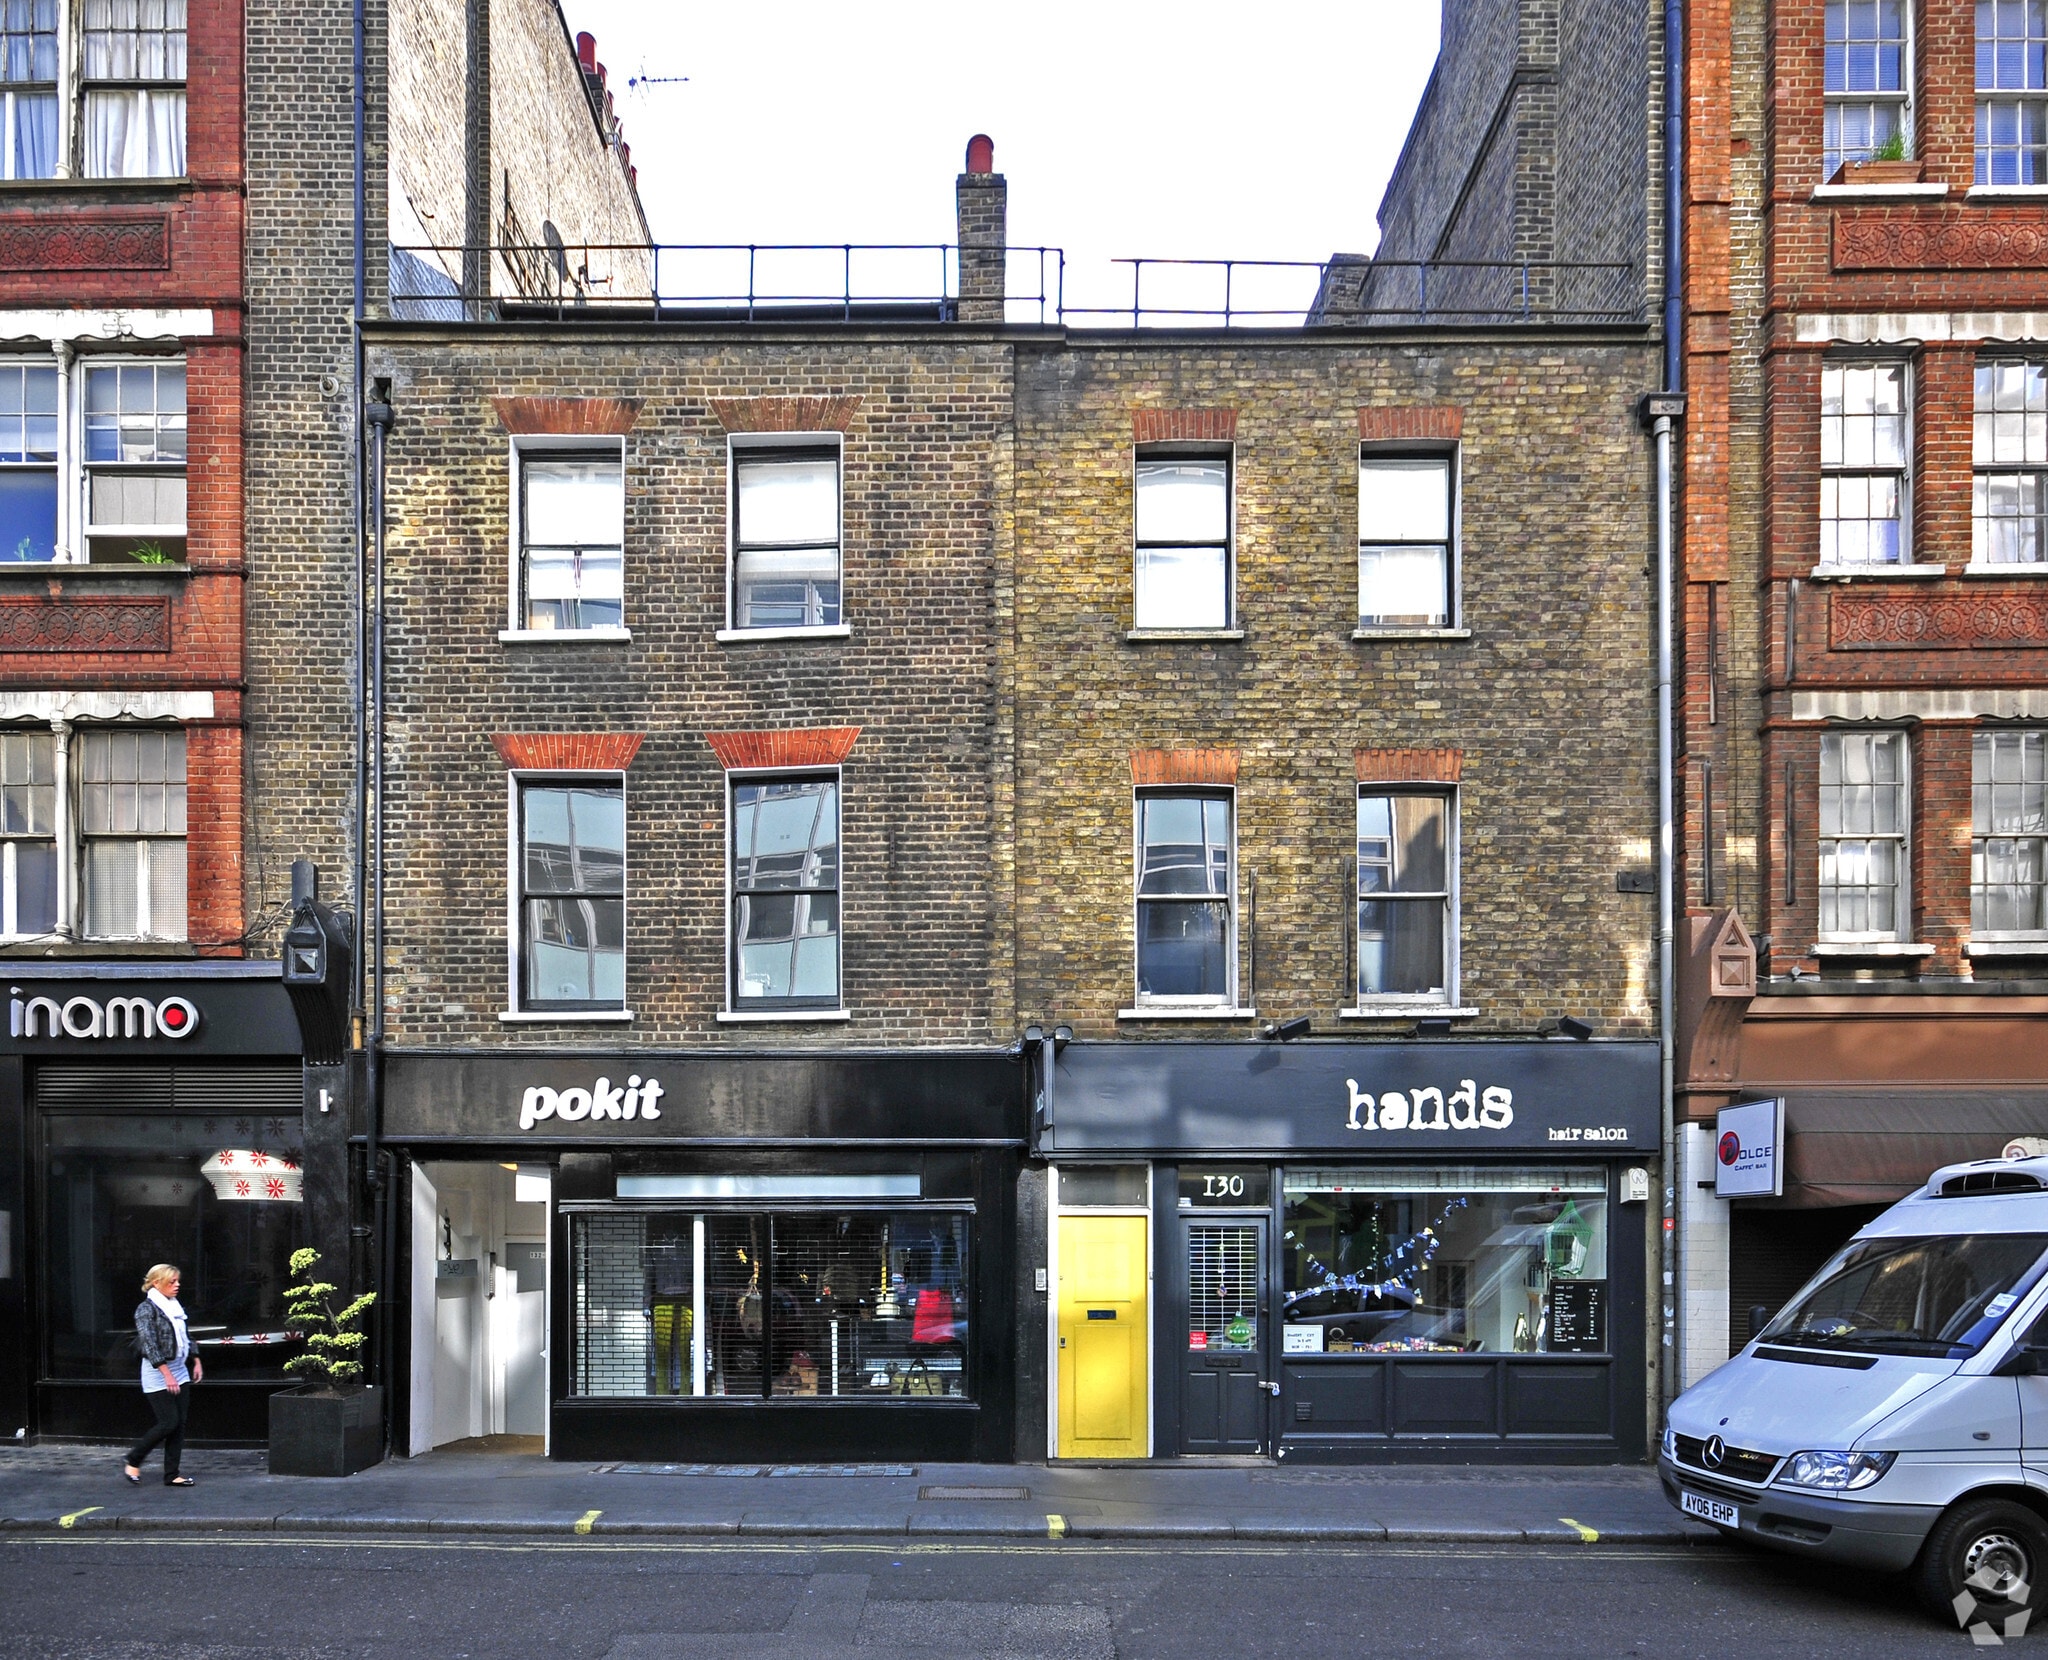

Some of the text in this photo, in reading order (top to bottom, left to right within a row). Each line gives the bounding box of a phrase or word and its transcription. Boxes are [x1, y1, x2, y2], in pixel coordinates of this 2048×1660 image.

[10, 986, 199, 1039] inamo
[518, 1074, 665, 1131] pokit
[1345, 1078, 1514, 1131] hands
[1548, 1126, 1628, 1141] hair salon
[1202, 1174, 1244, 1198] 130
[1686, 1494, 1734, 1522] AY06 EHP
